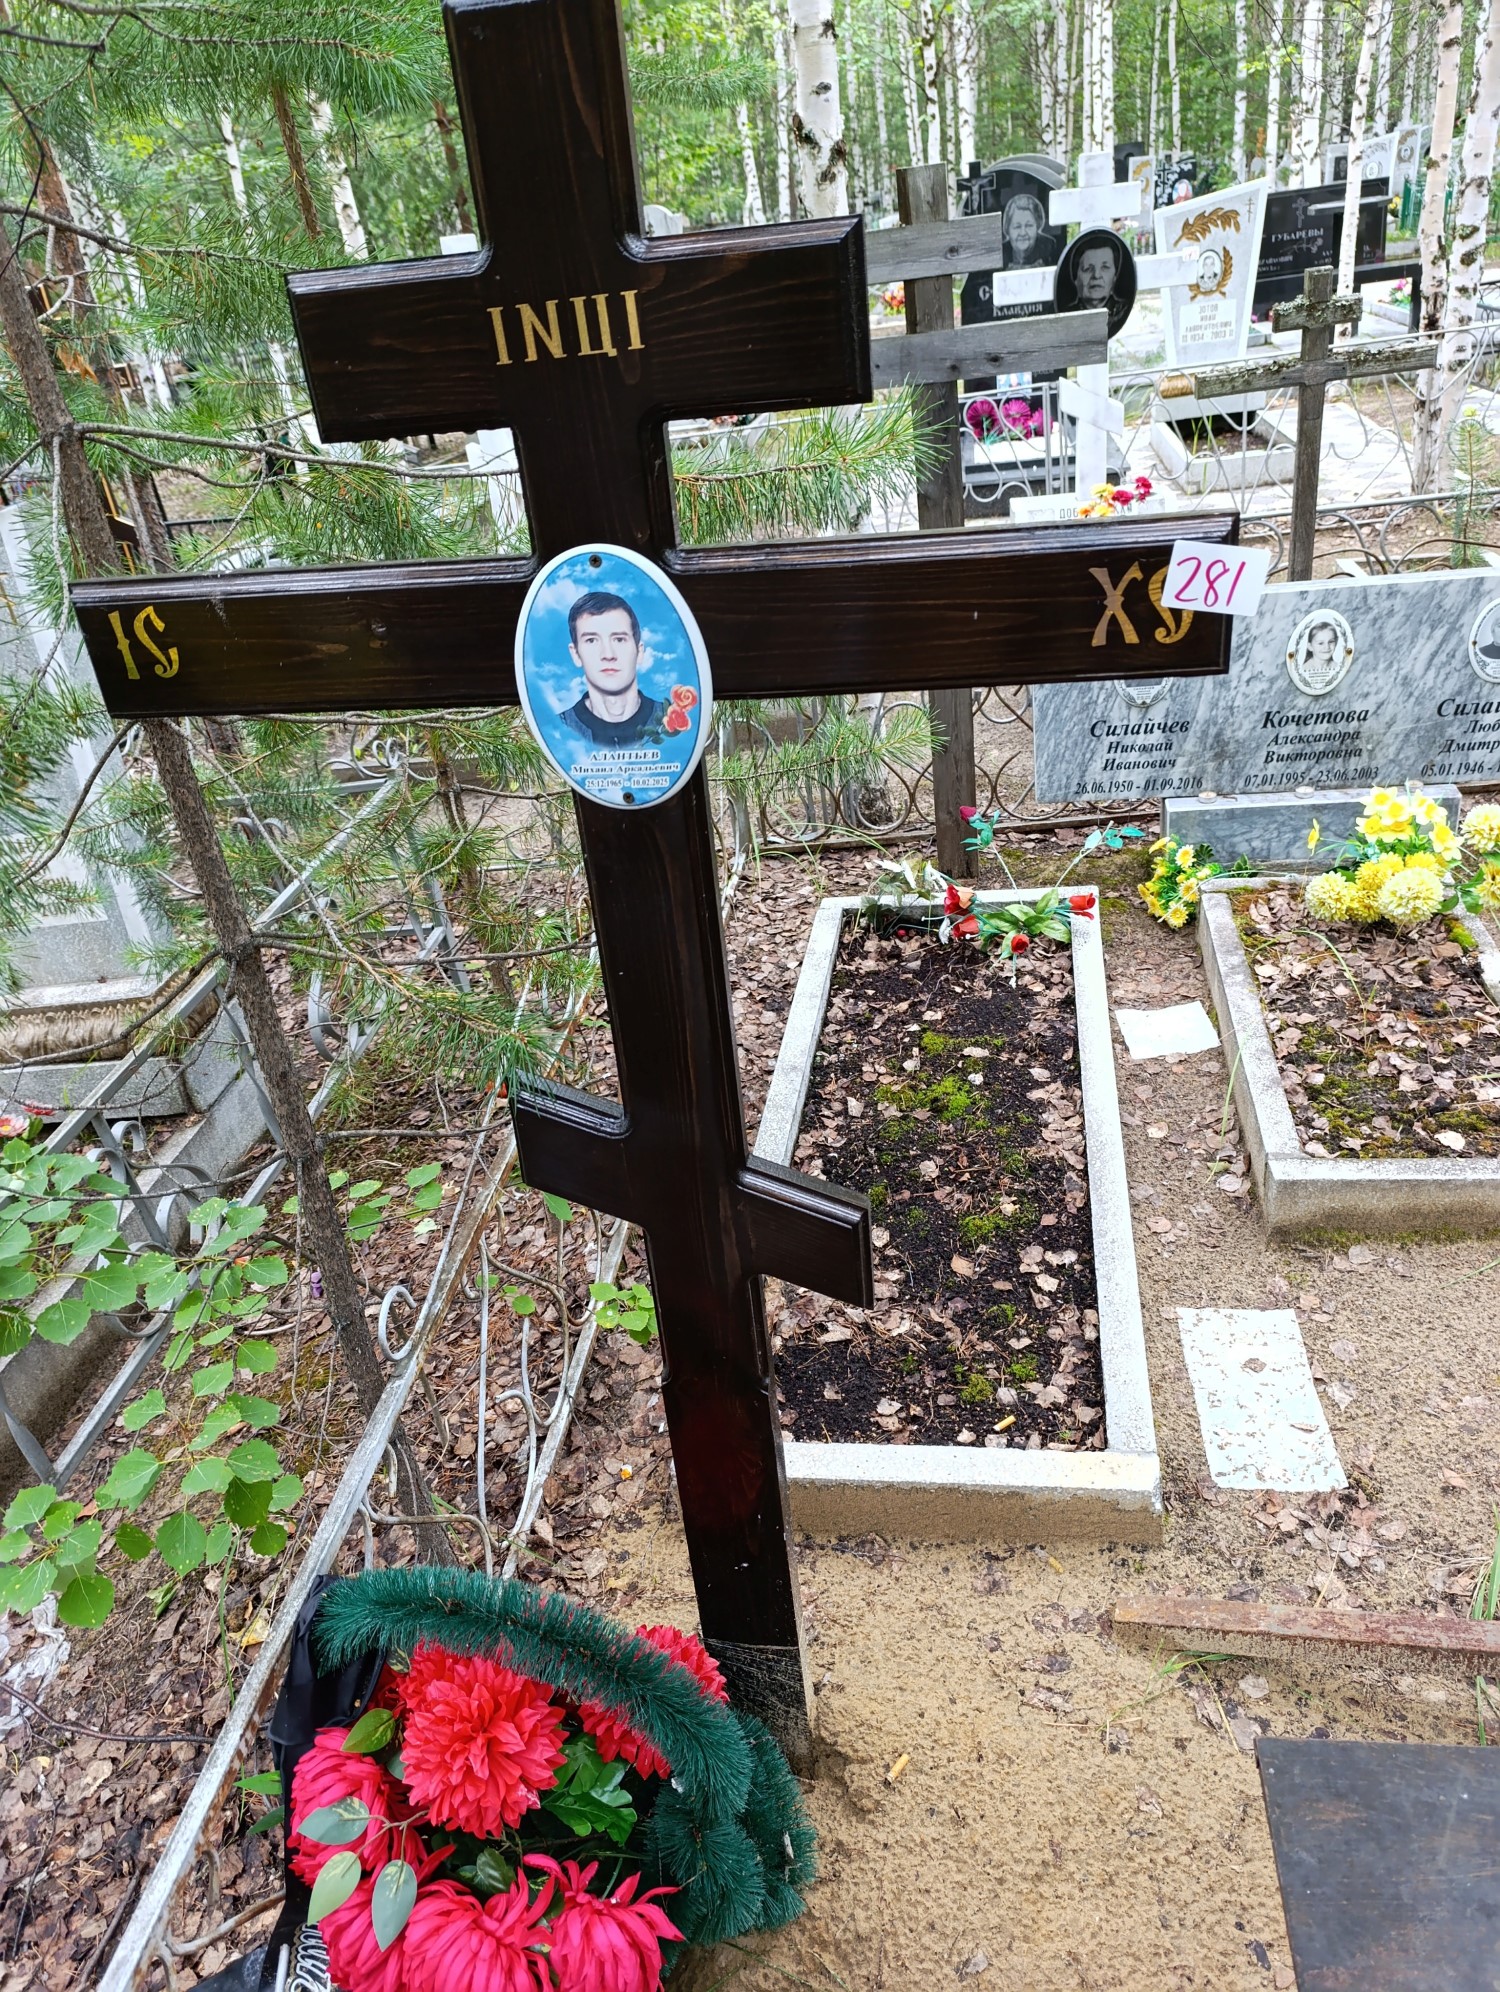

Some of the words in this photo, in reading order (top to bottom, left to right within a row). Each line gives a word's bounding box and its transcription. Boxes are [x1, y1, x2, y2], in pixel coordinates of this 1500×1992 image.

[1272, 228, 1323, 243] ГУБАРЕВЫ
[1174, 556, 1246, 608] 281
[1261, 709, 1369, 730] Кочетова
[1090, 718, 1190, 738] Силайчев
[1267, 729, 1361, 747] Александра
[1106, 738, 1173, 755] Николай
[590, 751, 660, 761] АЛАНТЬЕВ
[1264, 748, 1362, 764] Викторовна
[572, 766, 613, 774] Михаил
[1102, 758, 1177, 772] Иванович
[1421, 761, 1484, 777] 05.01.1946
[1317, 767, 1379, 783] 23.06.2003
[1075, 780, 1134, 795] 26.06.1950
[1144, 777, 1203, 791] 01.09.2016
